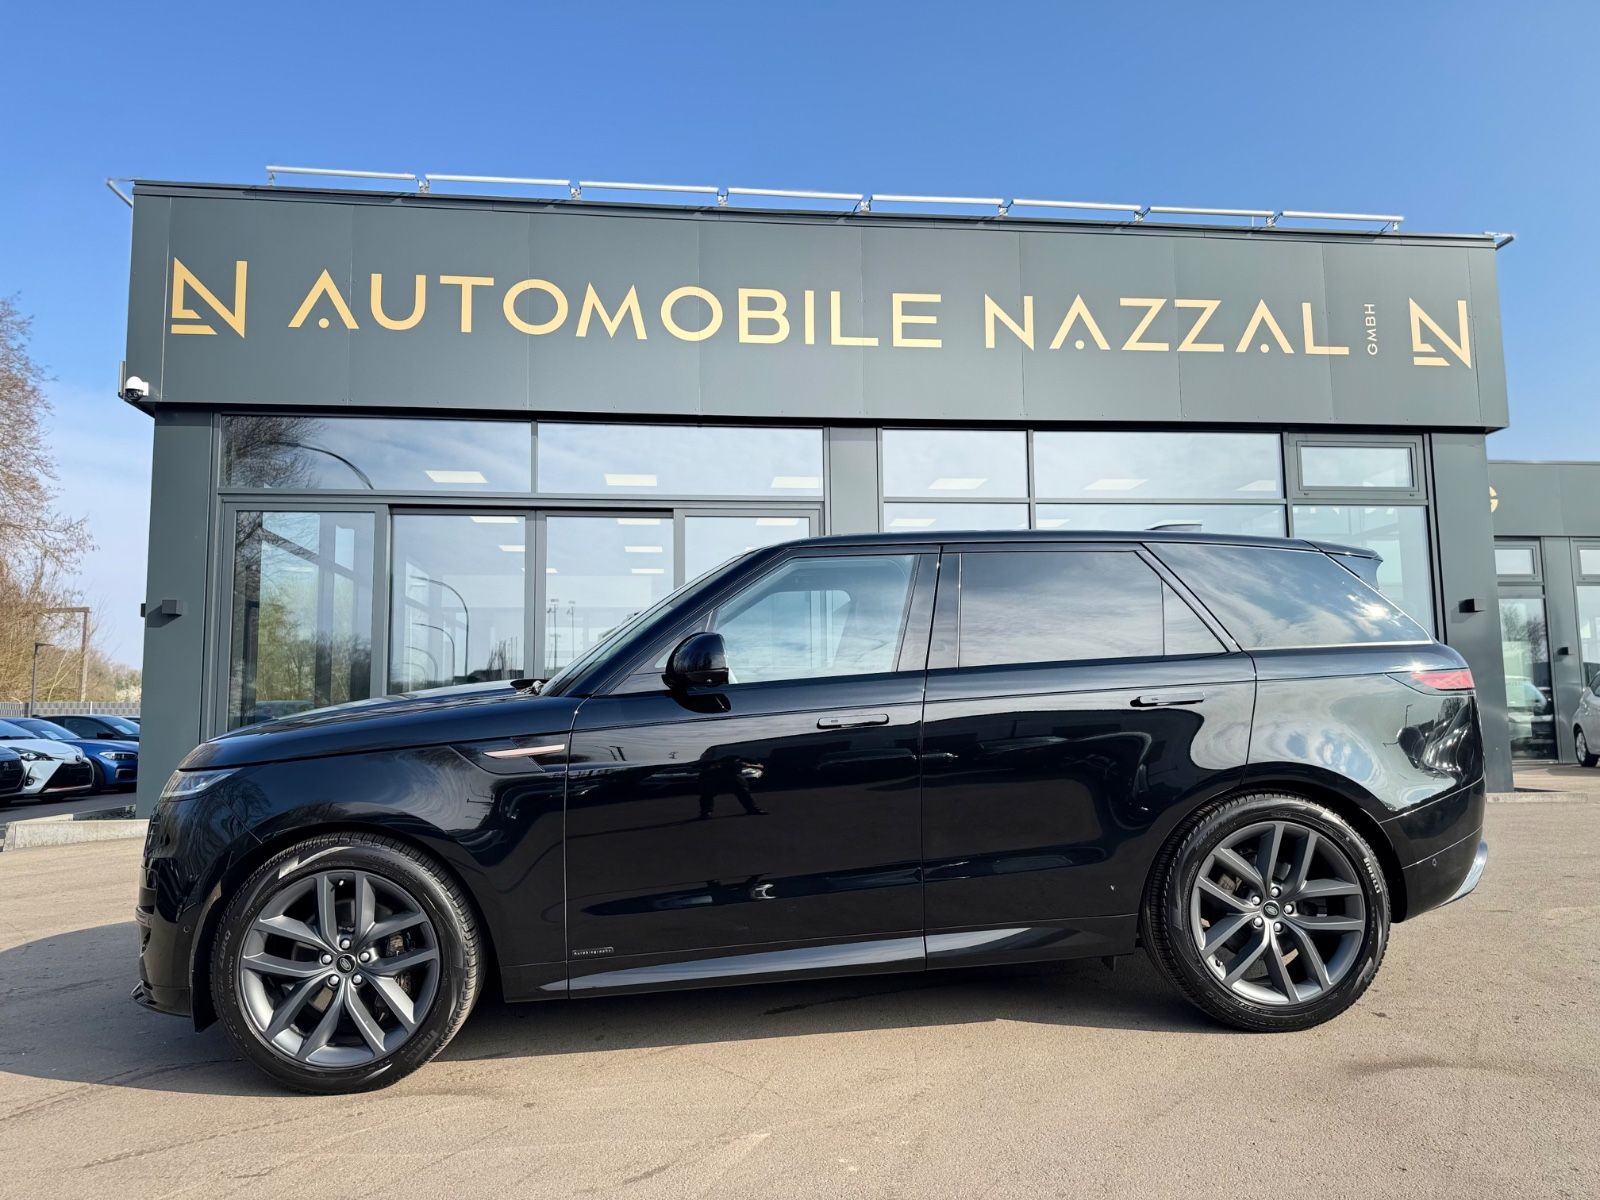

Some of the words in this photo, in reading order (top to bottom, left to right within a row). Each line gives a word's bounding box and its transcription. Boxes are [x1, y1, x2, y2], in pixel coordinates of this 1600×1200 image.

[288, 269, 943, 349] AUTOMOBILE
[983, 294, 1350, 357] NAZZAL
[1363, 303, 1378, 356] GMBH
